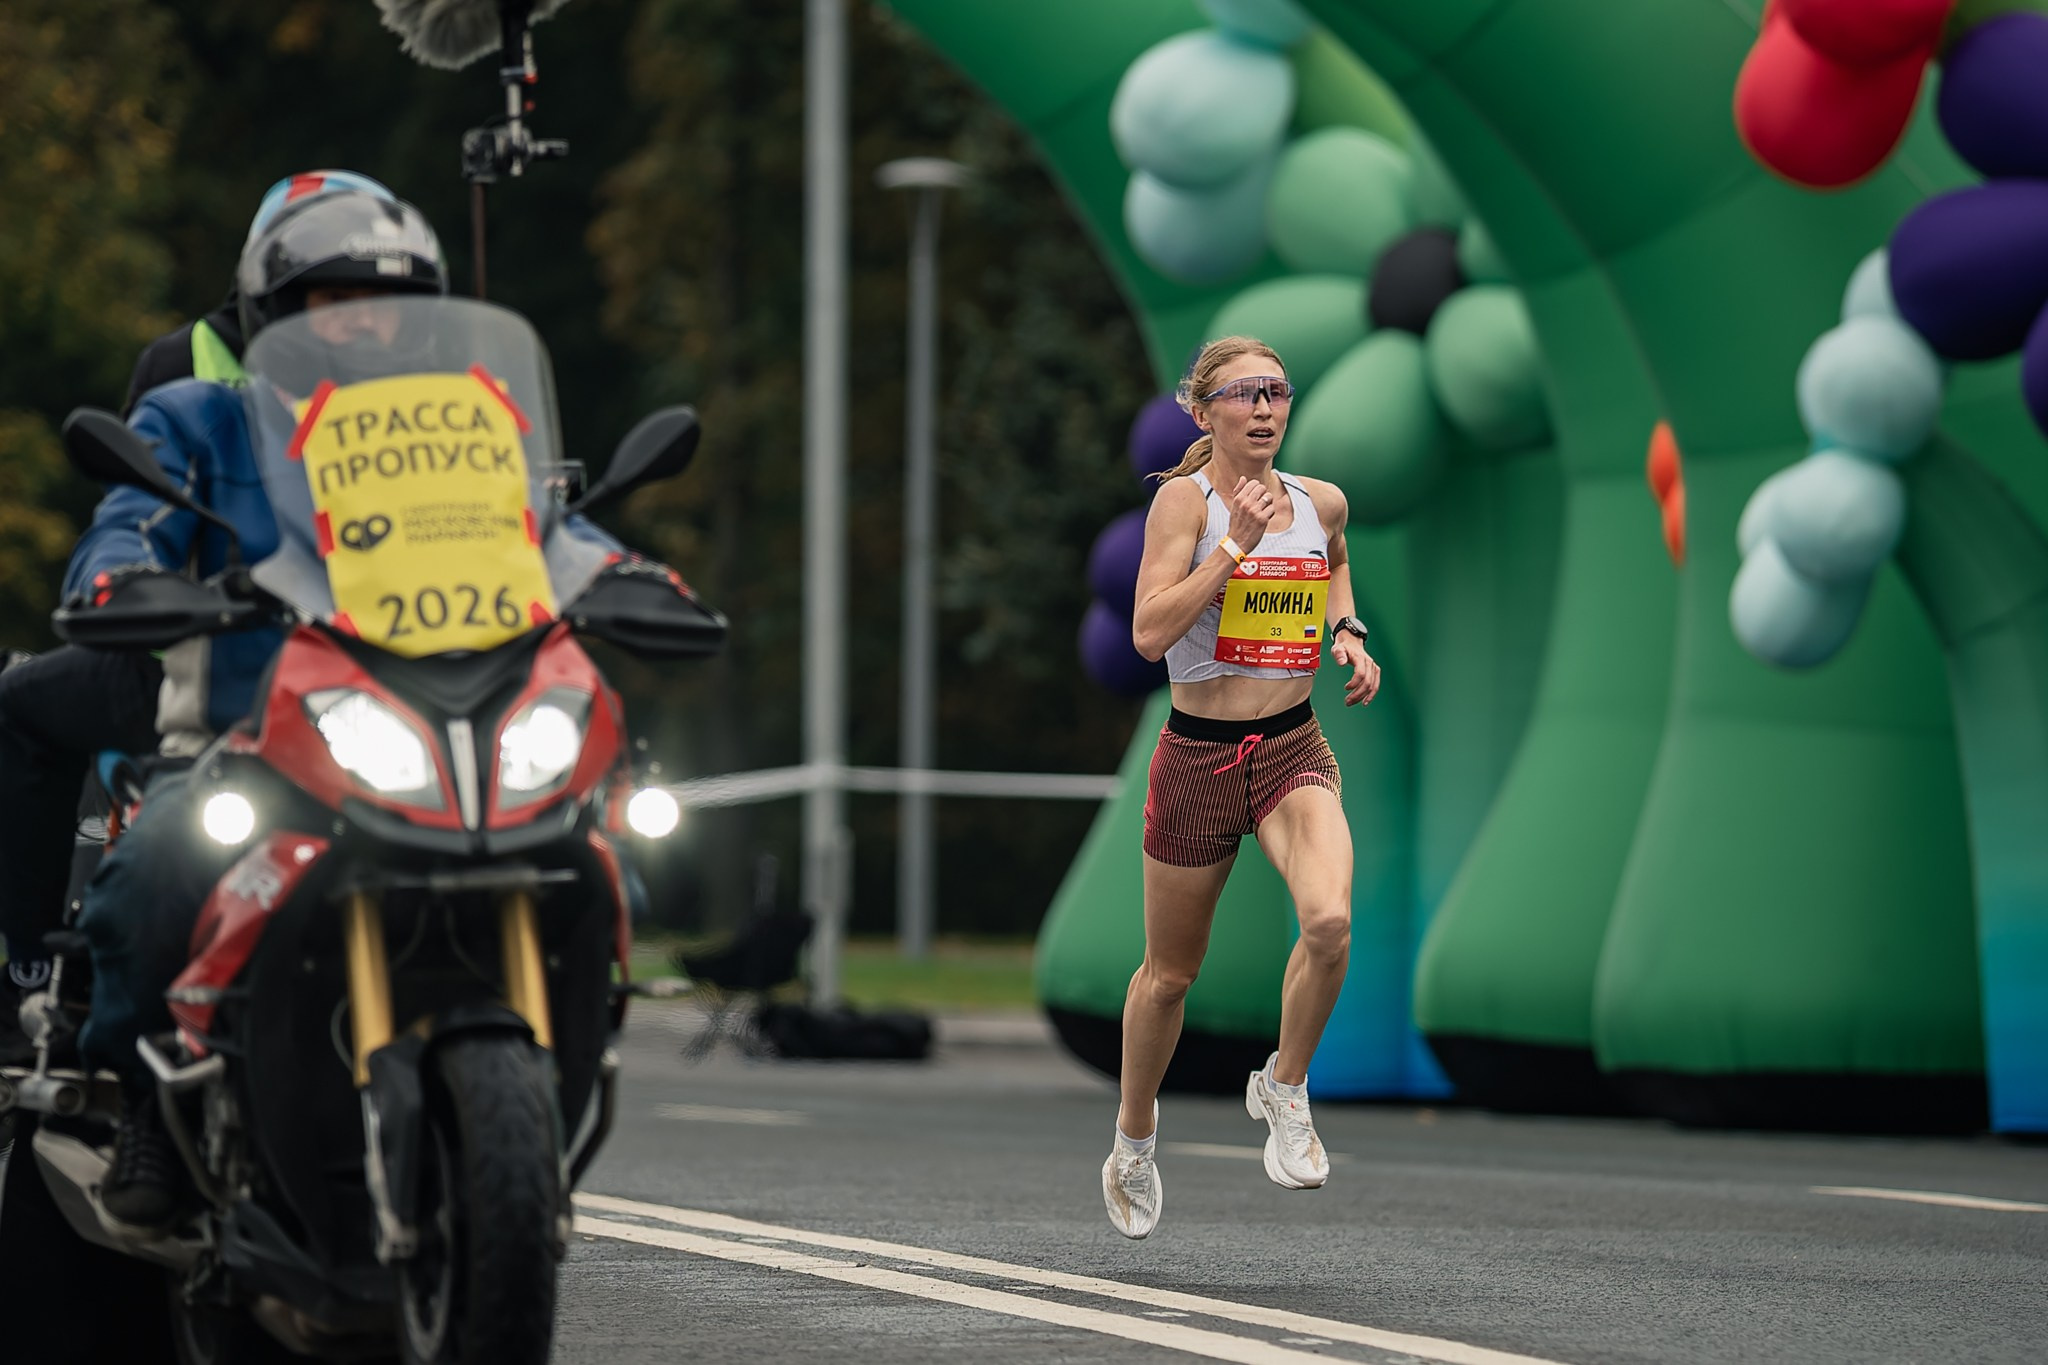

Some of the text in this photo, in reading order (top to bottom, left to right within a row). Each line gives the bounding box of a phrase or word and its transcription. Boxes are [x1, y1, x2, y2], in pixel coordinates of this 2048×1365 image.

[327, 401, 494, 449] ТРАССА
[318, 443, 519, 494] ПРОПУСК
[378, 584, 522, 643] 2026
[1243, 591, 1313, 615] МОКИНА
[1270, 627, 1282, 637] 33
